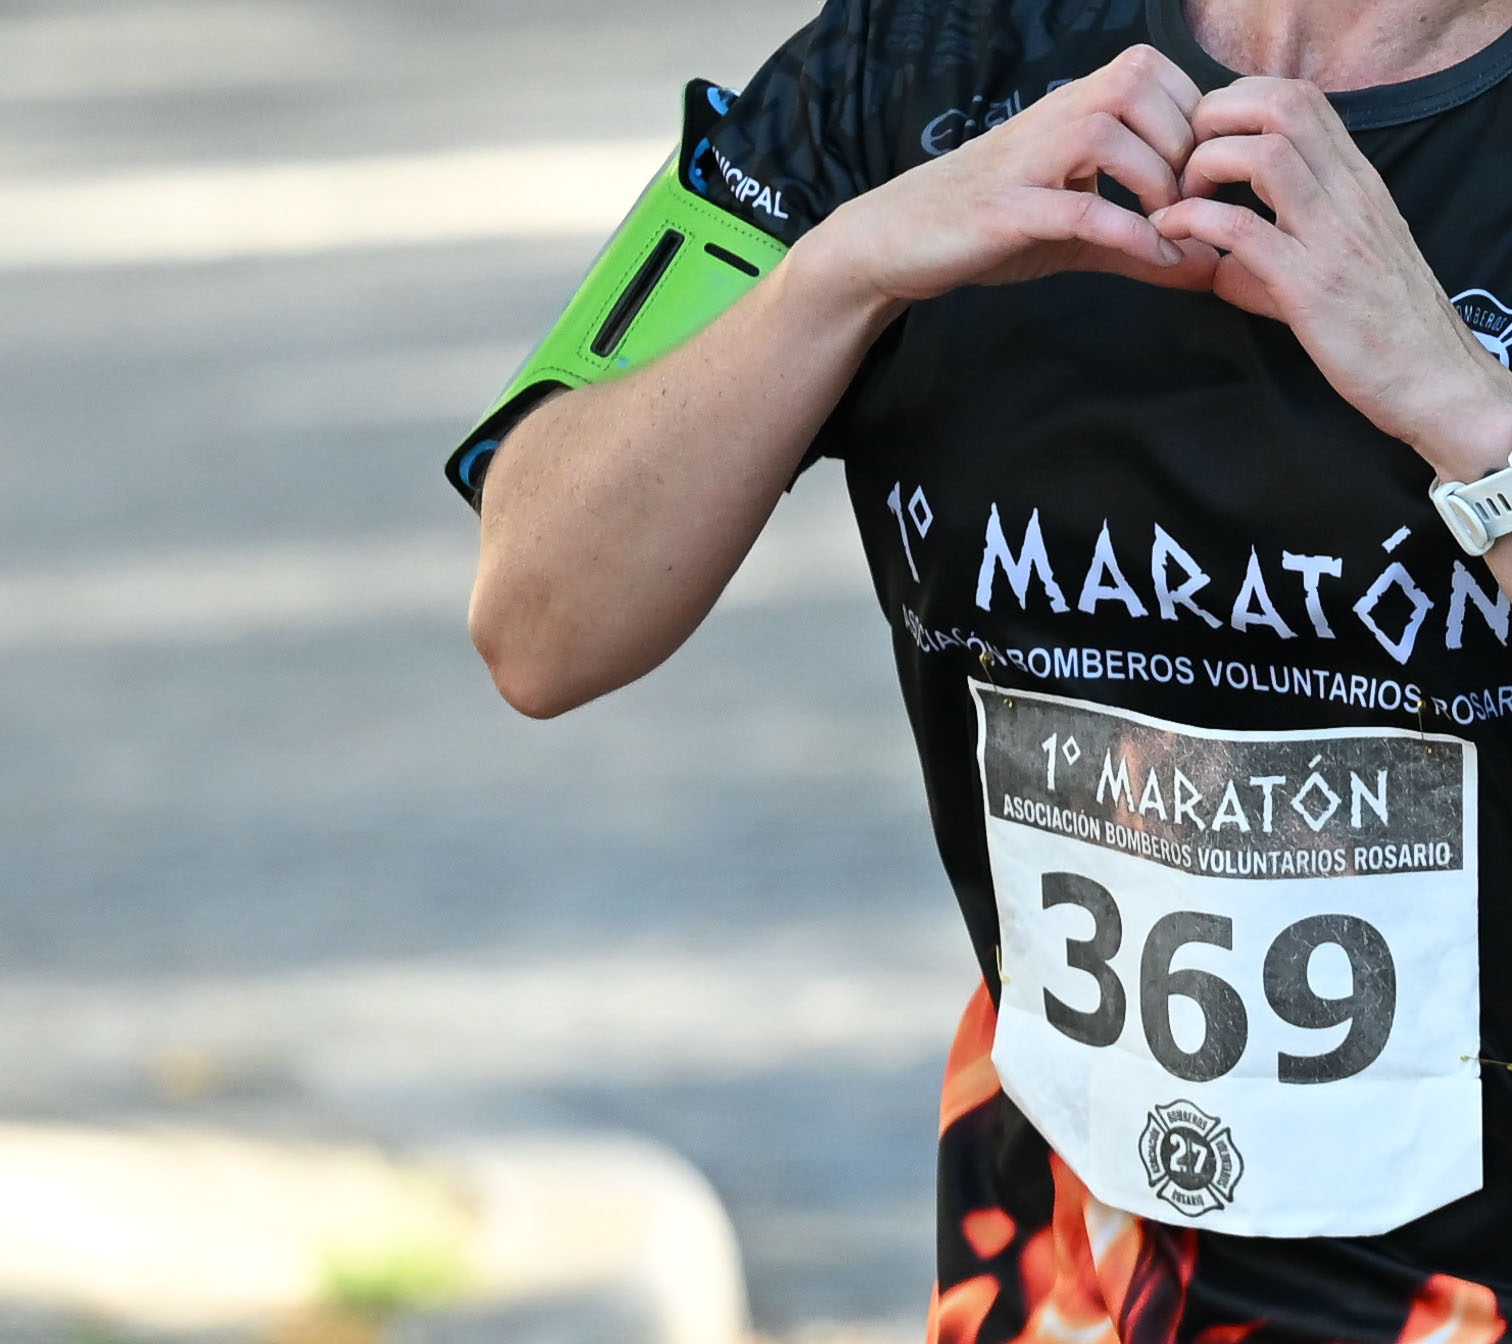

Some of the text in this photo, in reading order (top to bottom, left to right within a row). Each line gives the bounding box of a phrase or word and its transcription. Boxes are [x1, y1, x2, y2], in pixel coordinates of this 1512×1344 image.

[975, 501, 1512, 665] MARATÓN
[1006, 647, 1195, 686] BOMBEROS
[1206, 659, 1422, 714] VOLUNTARIOS
[1095, 746, 1389, 834] MARATÓN
[1003, 792, 1452, 876] ASOCIACIÓN BOMBEROS VOLUNTARIOS ROSARIO
[1041, 870, 1397, 1085] 369
[1169, 1132, 1208, 1175] 27
